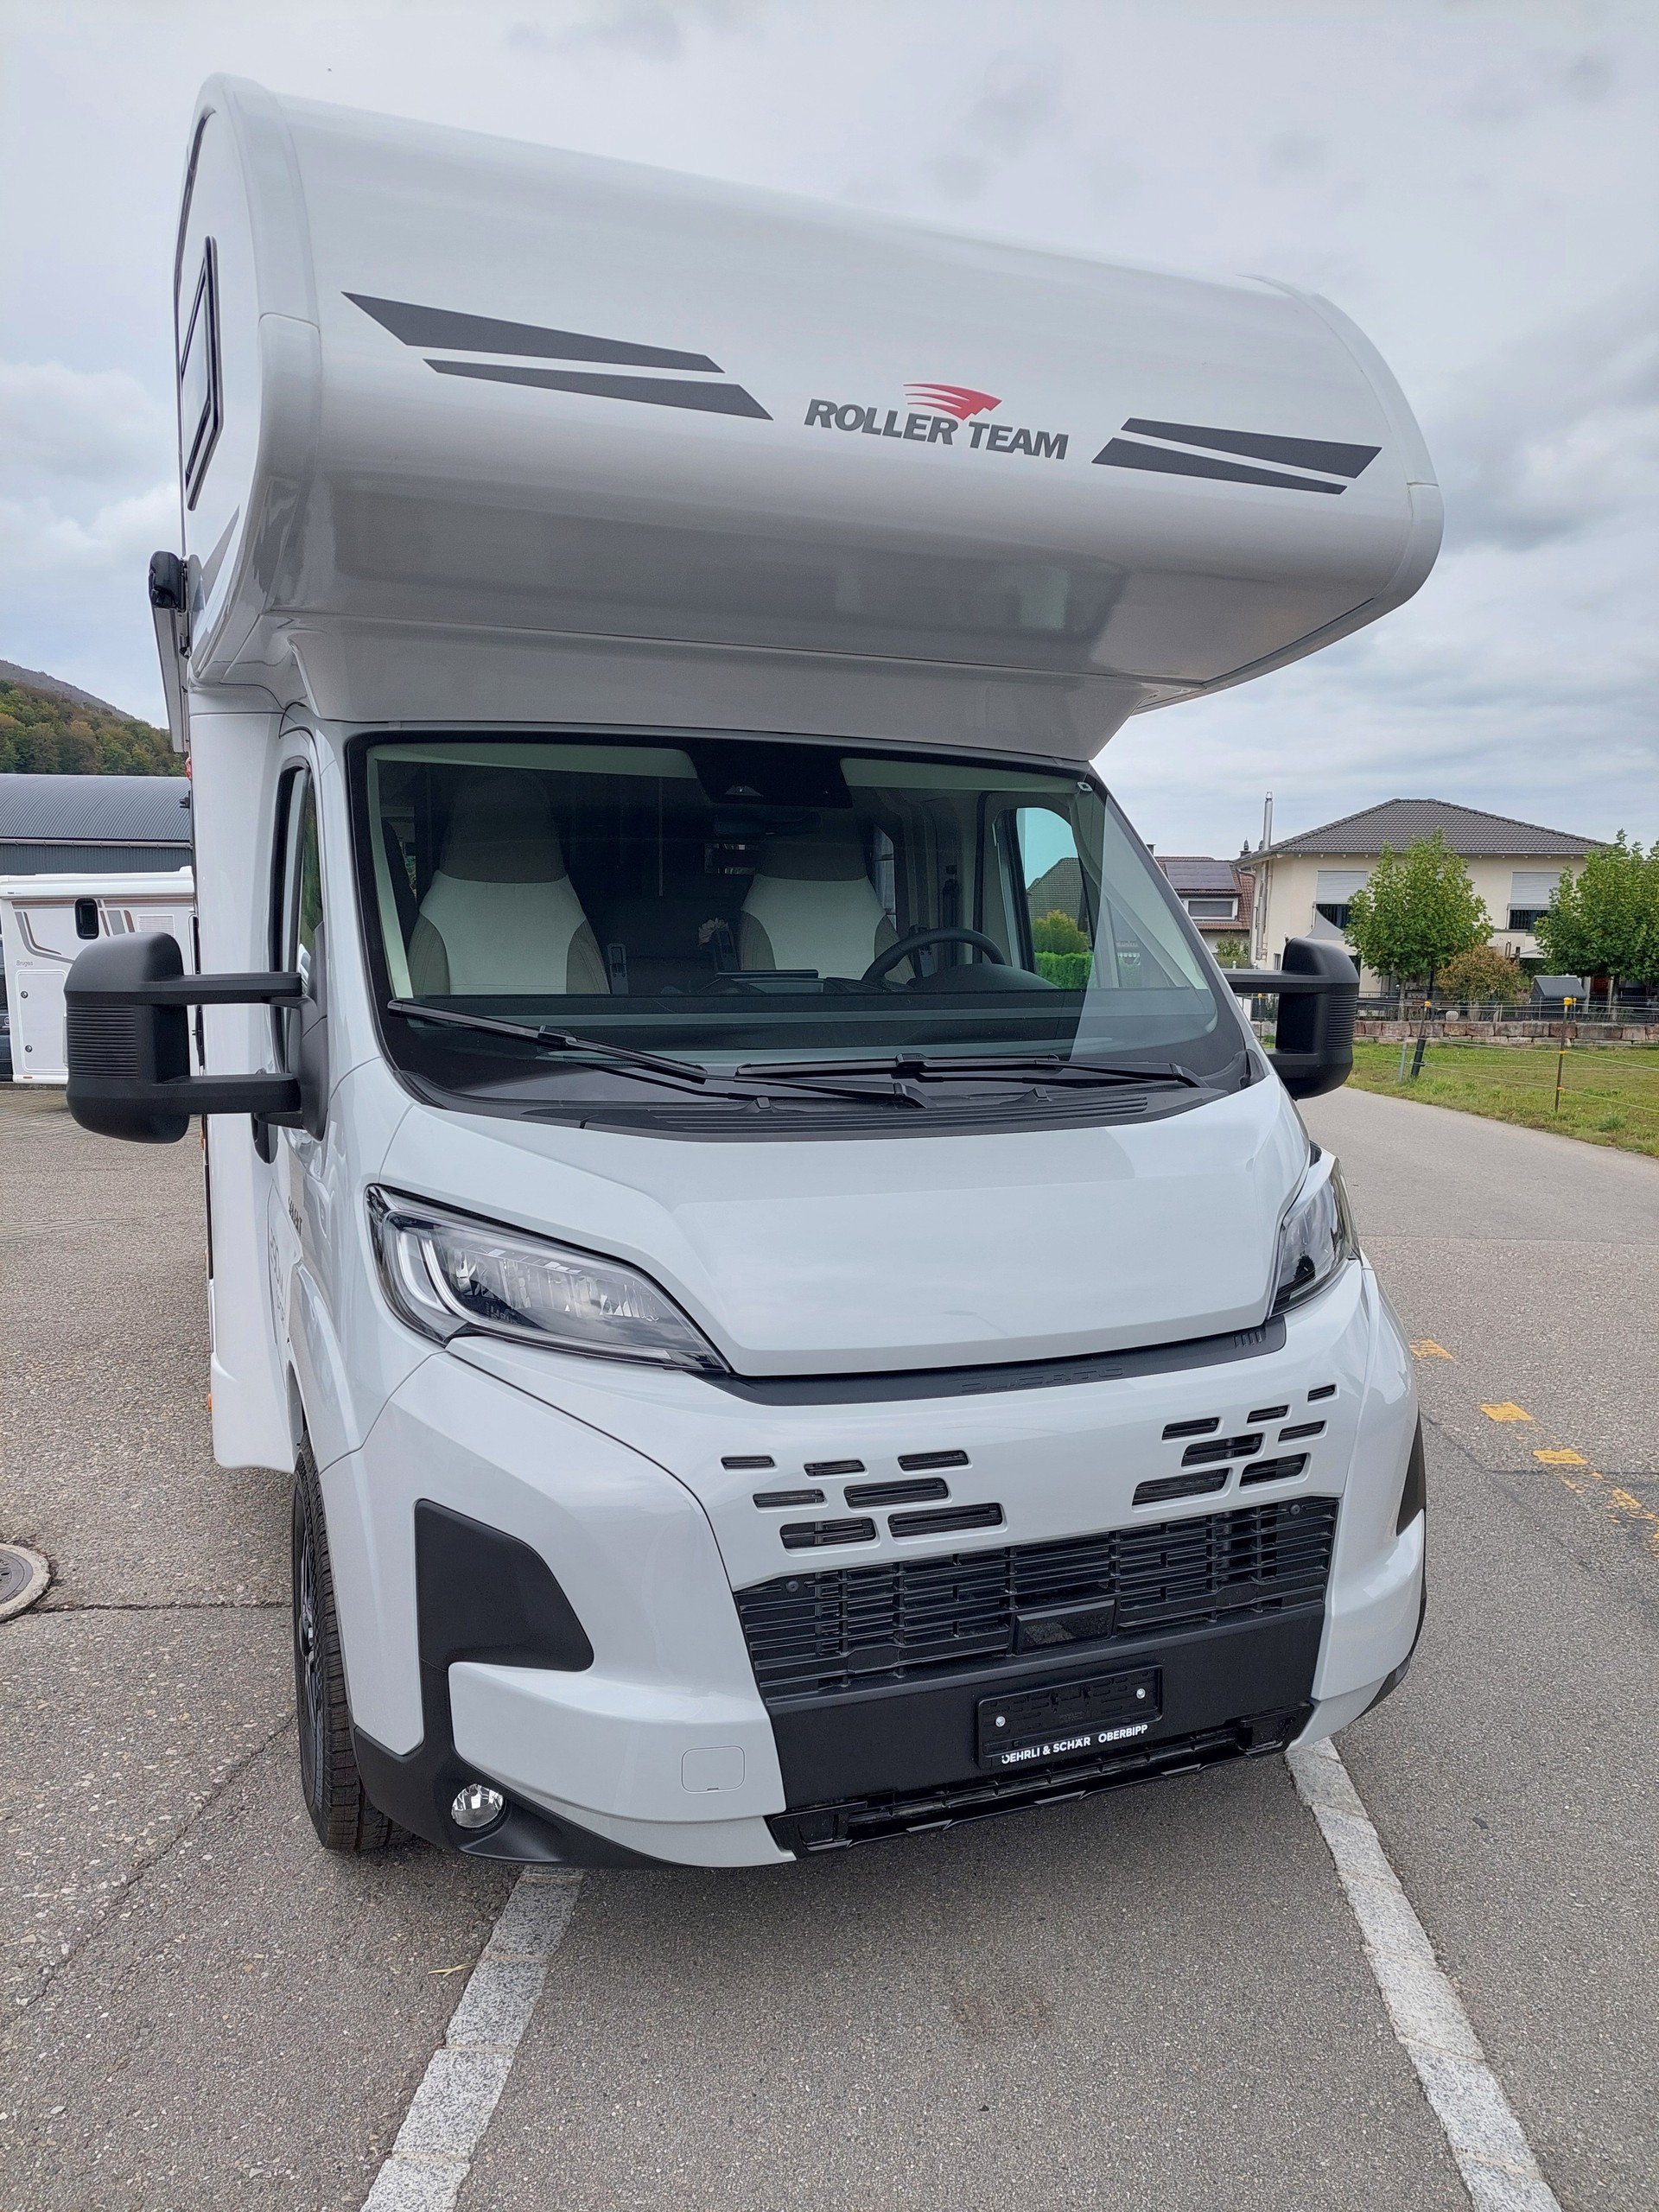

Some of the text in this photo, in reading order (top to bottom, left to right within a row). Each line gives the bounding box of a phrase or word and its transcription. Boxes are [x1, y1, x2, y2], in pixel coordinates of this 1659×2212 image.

[804, 398, 1070, 460] ROLLER TEAM
[1042, 1745, 1051, 1756] &
[1052, 1737, 1091, 1753] SCHÄR
[1098, 1725, 1148, 1743] OBERBIPP
